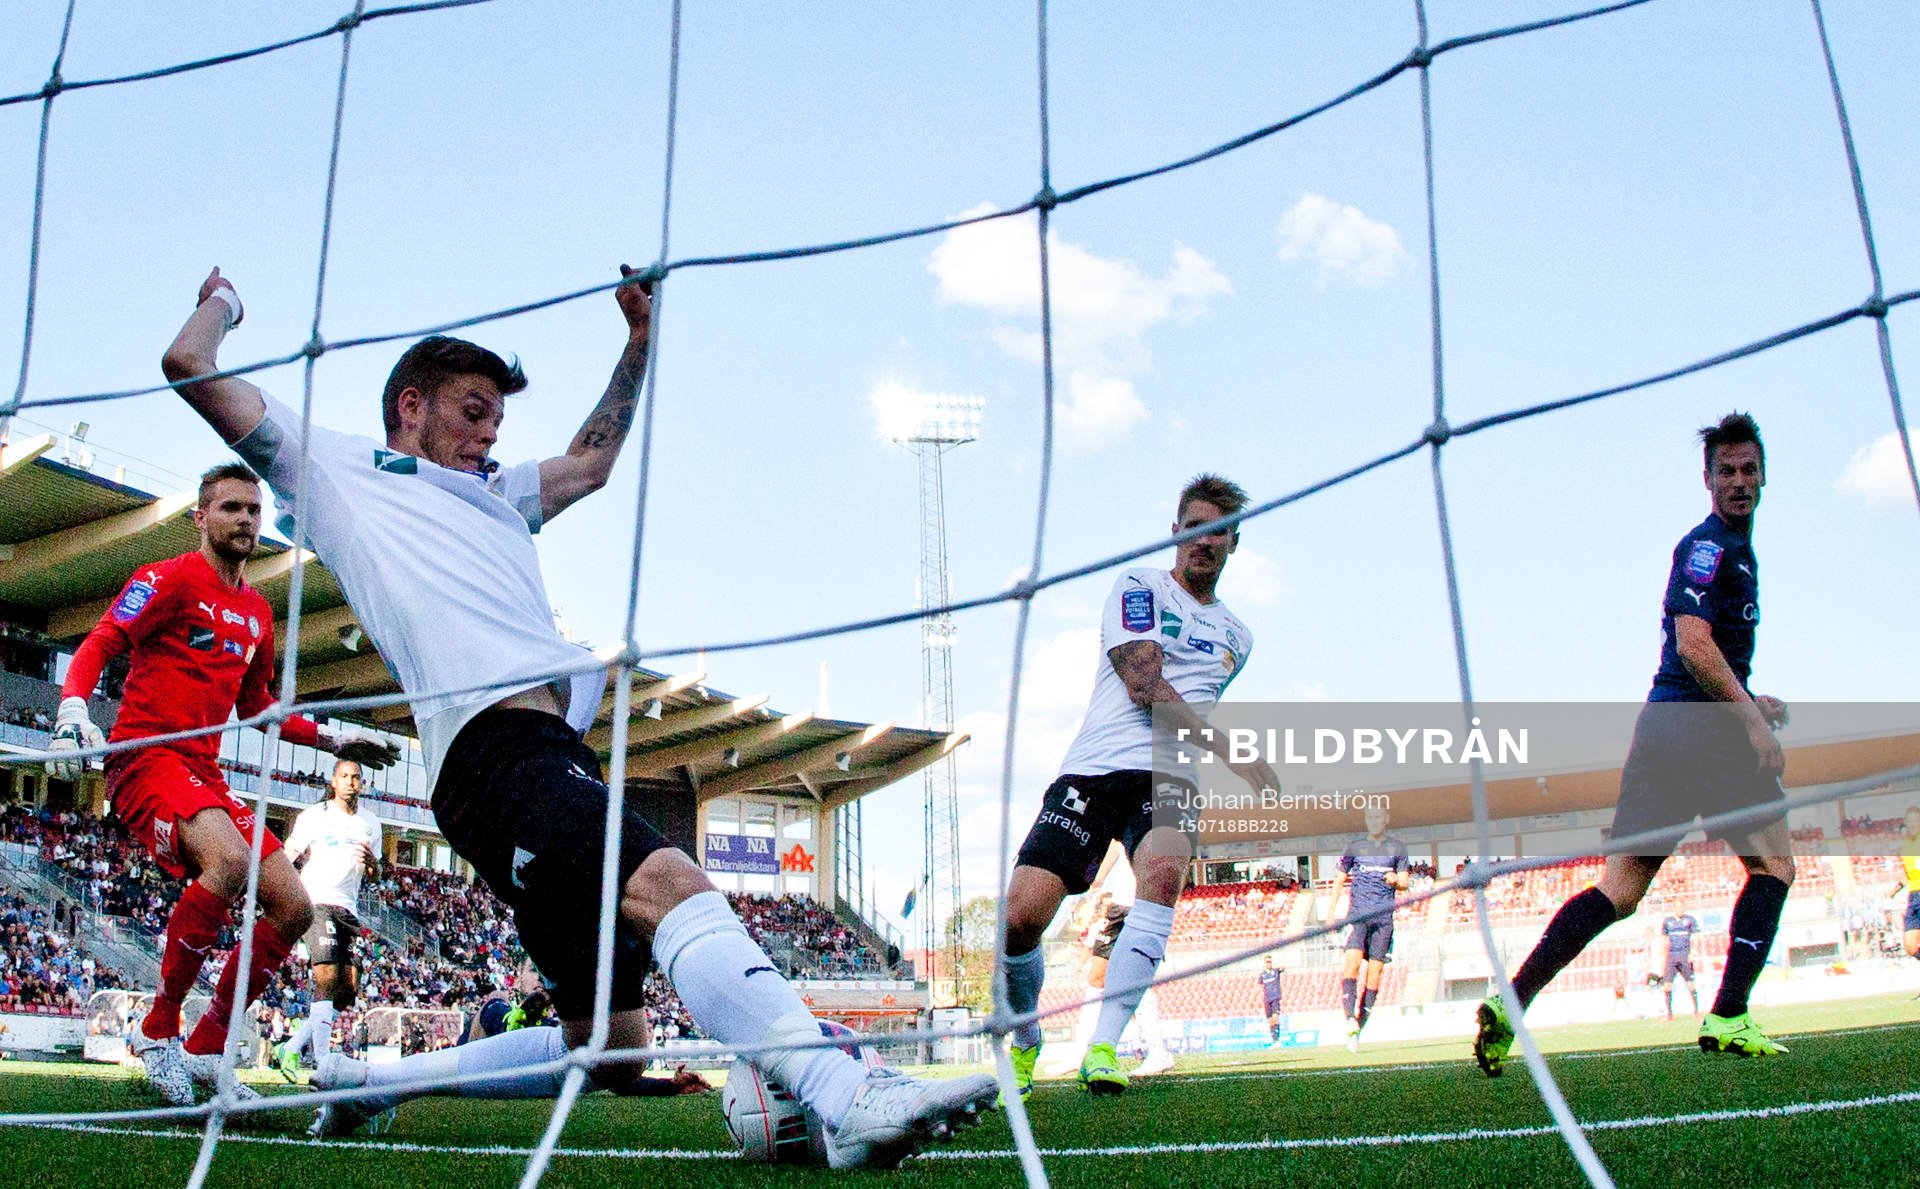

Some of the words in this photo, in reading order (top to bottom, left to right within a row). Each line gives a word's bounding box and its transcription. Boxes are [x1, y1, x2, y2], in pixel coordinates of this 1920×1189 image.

[1039, 810, 1091, 846] Strateg
[707, 835, 731, 852] NA
[746, 838, 770, 854] NA
